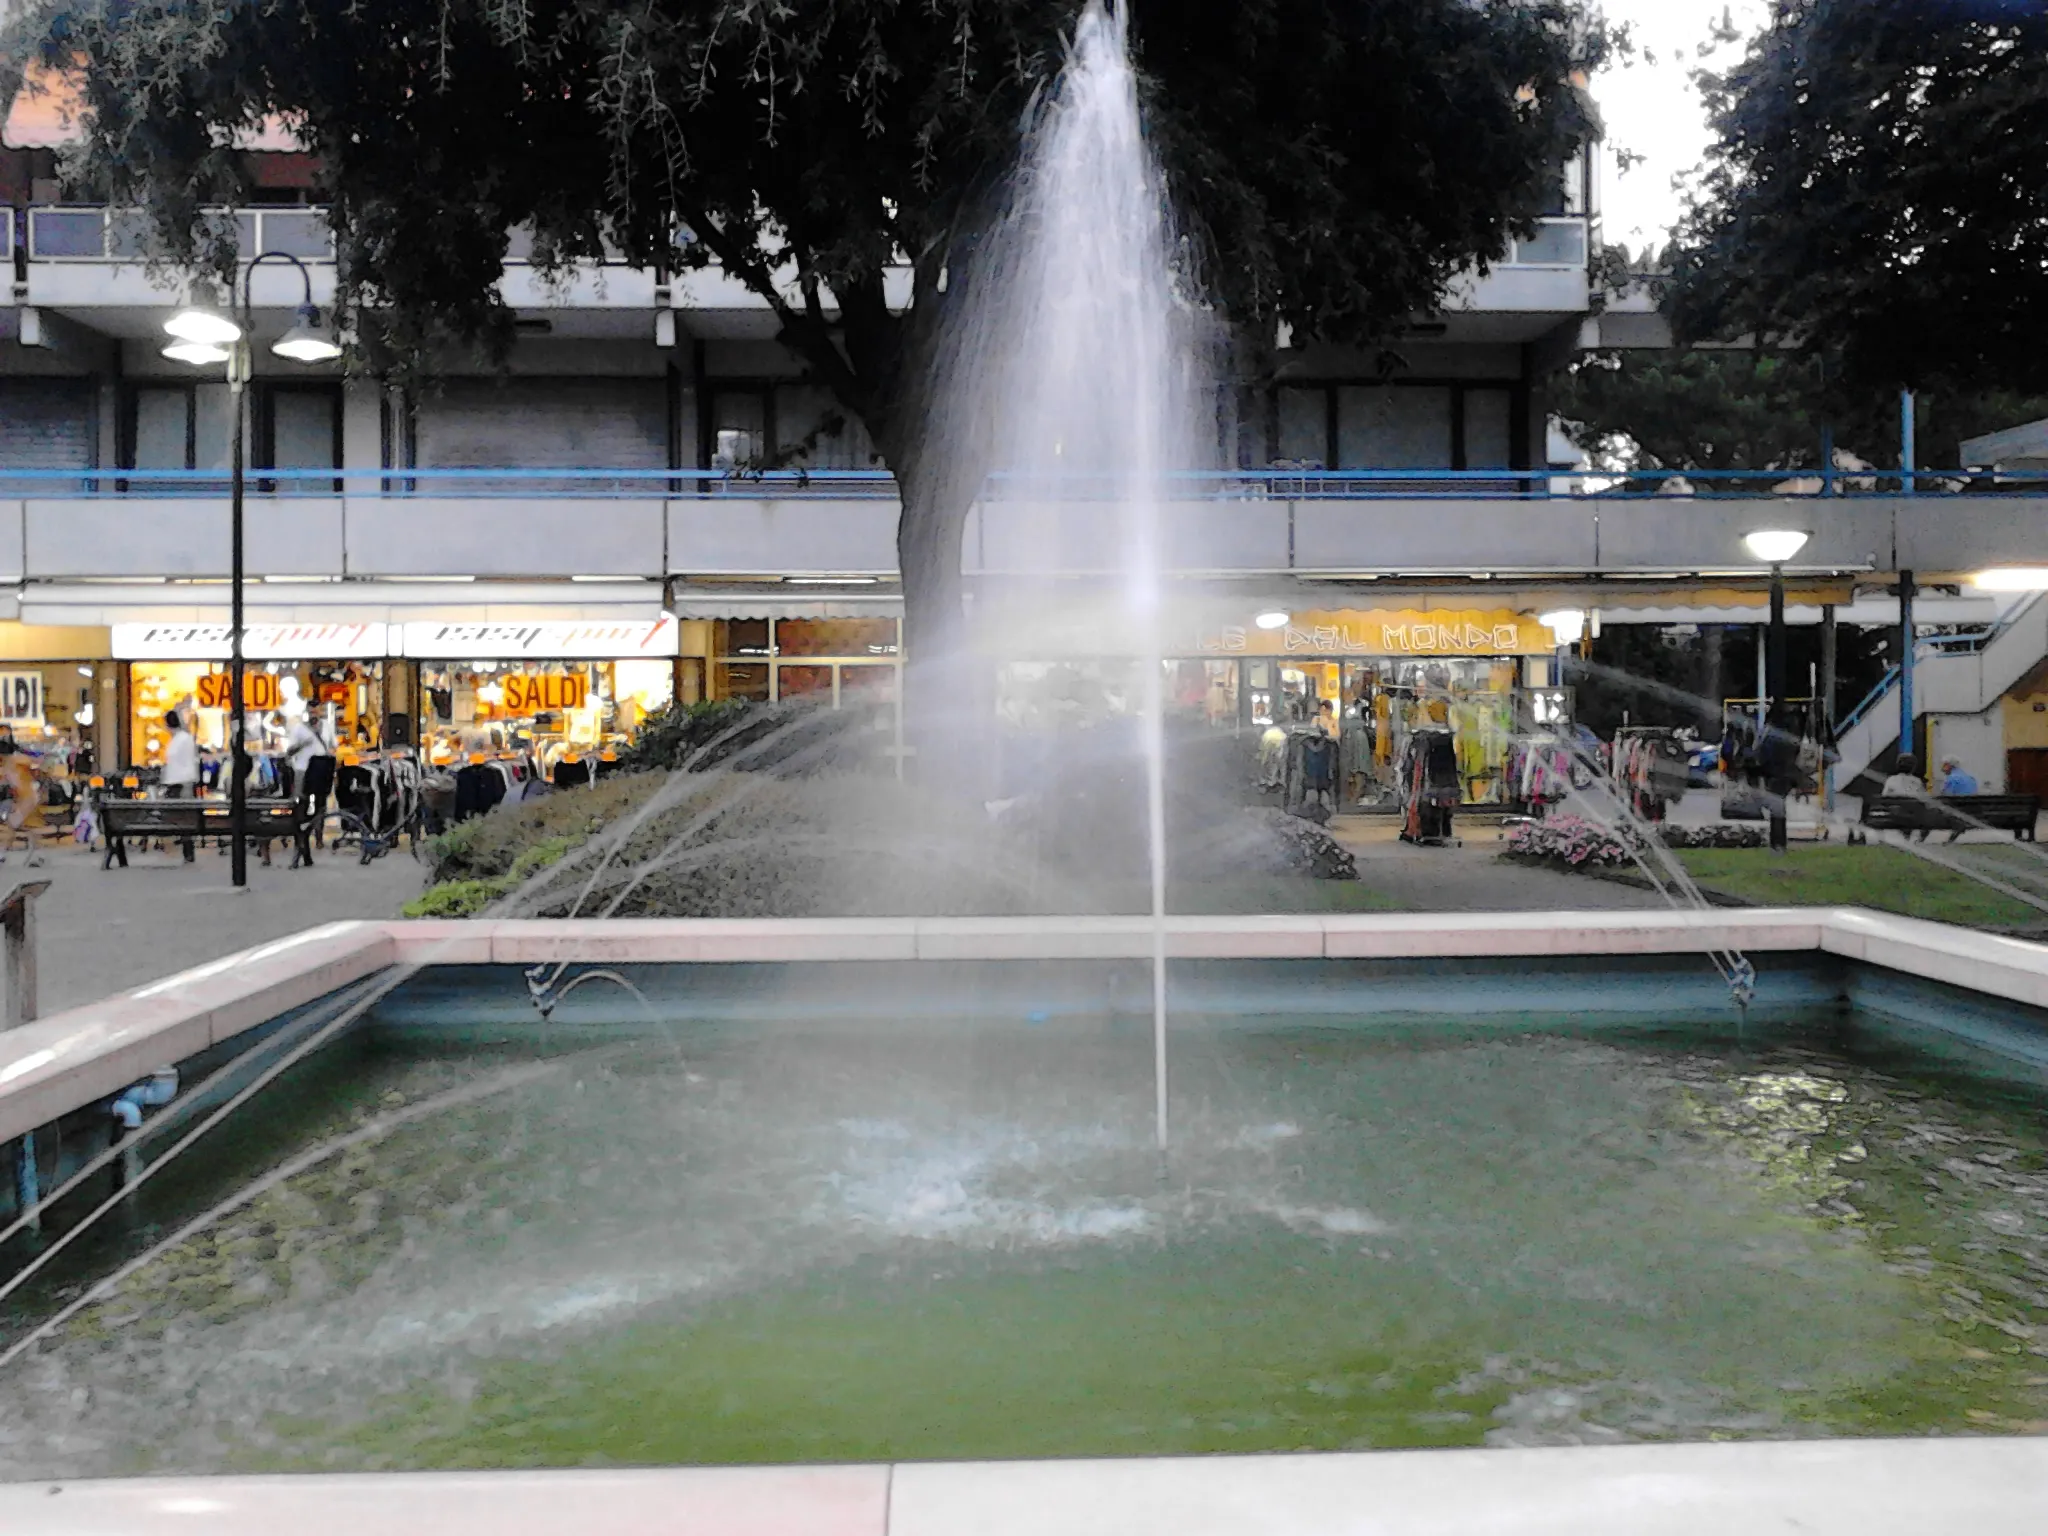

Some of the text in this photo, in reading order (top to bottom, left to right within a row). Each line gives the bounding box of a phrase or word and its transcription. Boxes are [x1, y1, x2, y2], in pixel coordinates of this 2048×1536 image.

[1283, 624, 1366, 650] DAL
[1382, 623, 1519, 651] MONDO
[199, 674, 278, 709] SADI
[506, 676, 586, 709] SALDI
